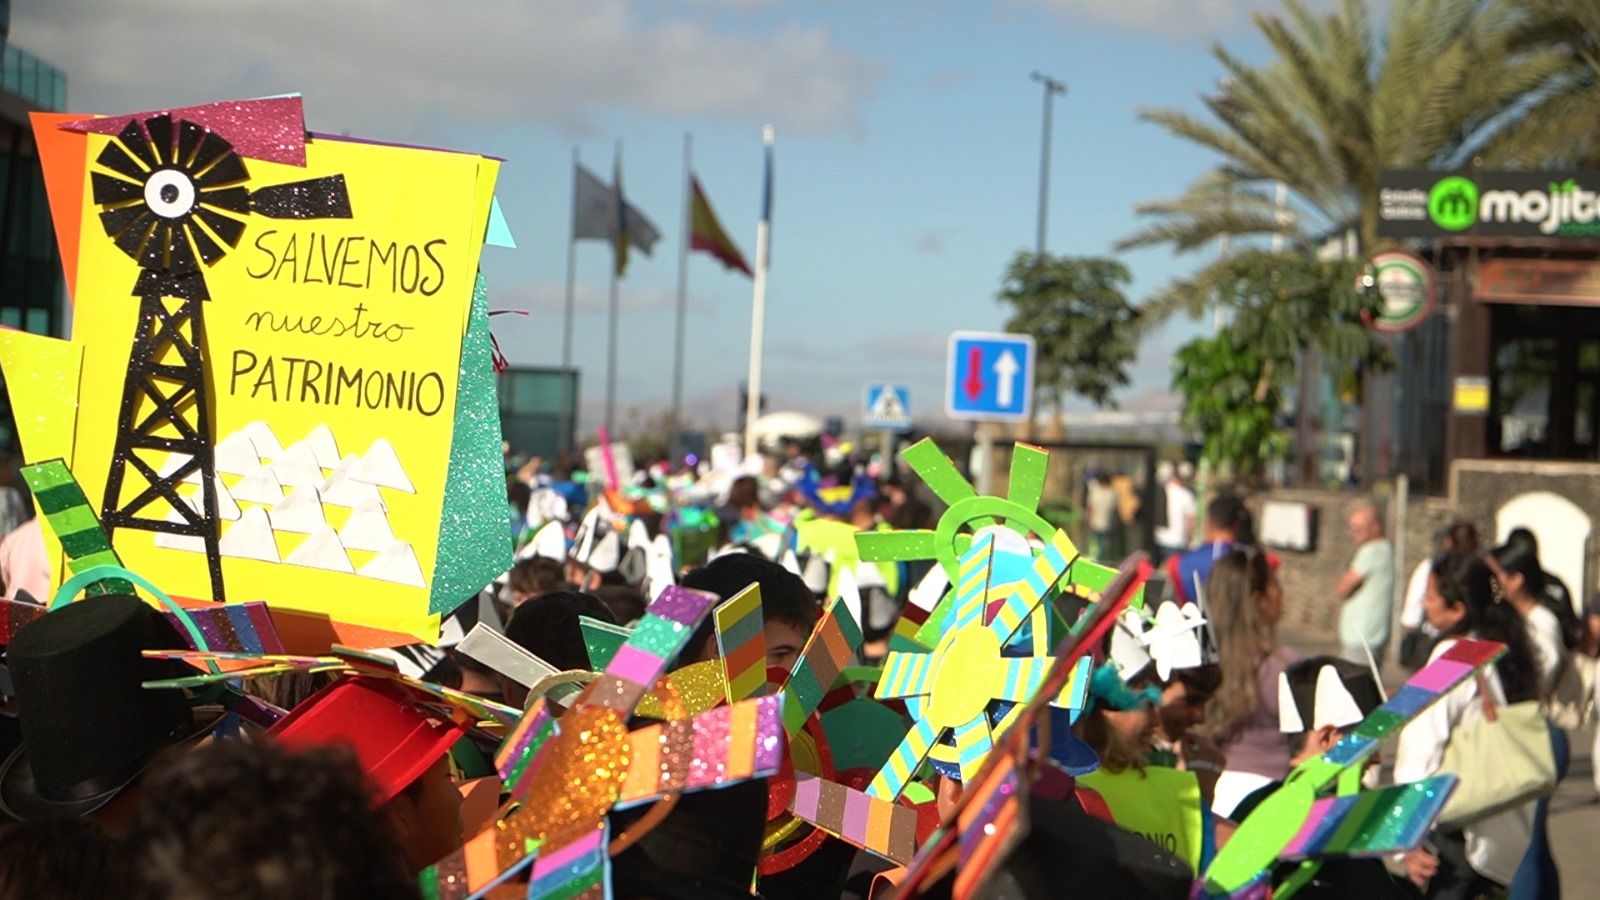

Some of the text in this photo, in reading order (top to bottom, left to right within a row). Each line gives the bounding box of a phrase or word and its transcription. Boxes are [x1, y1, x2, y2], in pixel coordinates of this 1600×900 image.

[1479, 178, 1600, 235] mojit
[246, 229, 448, 297] SALVEMOS
[244, 302, 415, 343] nuestro
[229, 349, 445, 417] PATRIMONIO
